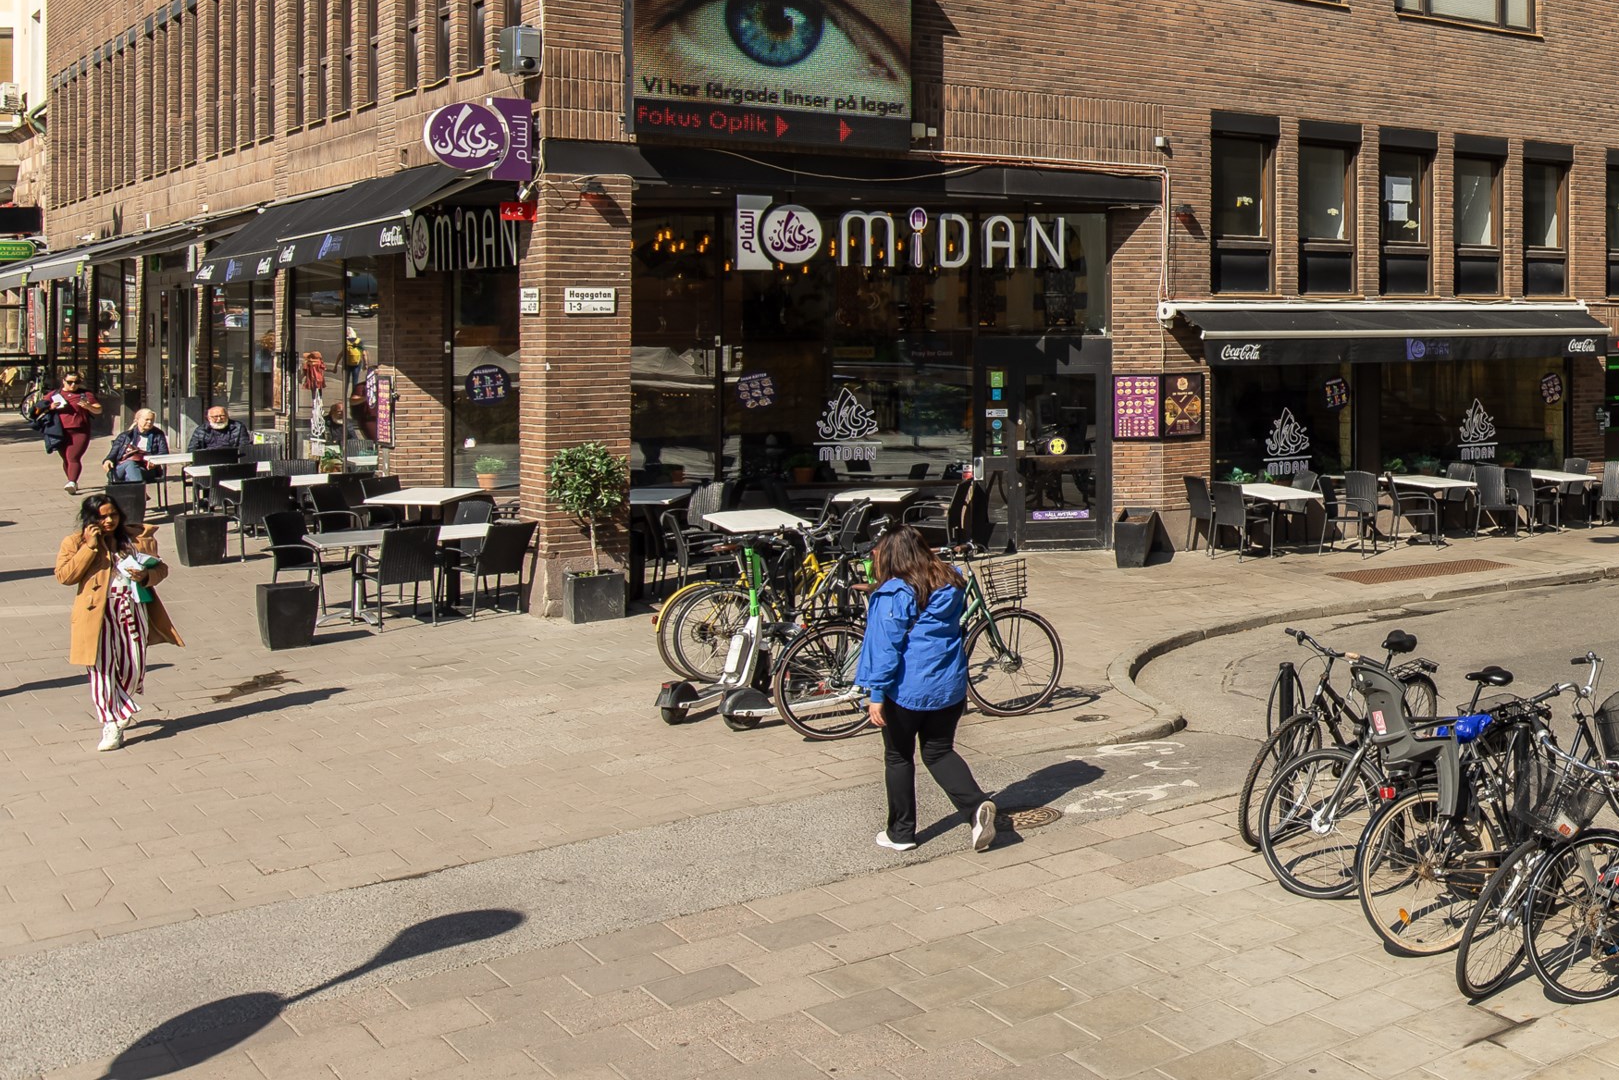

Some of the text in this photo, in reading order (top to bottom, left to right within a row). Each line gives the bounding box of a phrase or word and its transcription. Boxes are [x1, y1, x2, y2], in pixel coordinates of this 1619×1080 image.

[642, 75, 905, 117] Vi har färgade linser på lager
[637, 106, 769, 137] Fokus Optik
[569, 290, 612, 300] Hagagatan
[569, 302, 583, 311] 1-3
[1221, 344, 1262, 361] Coca-Cola
